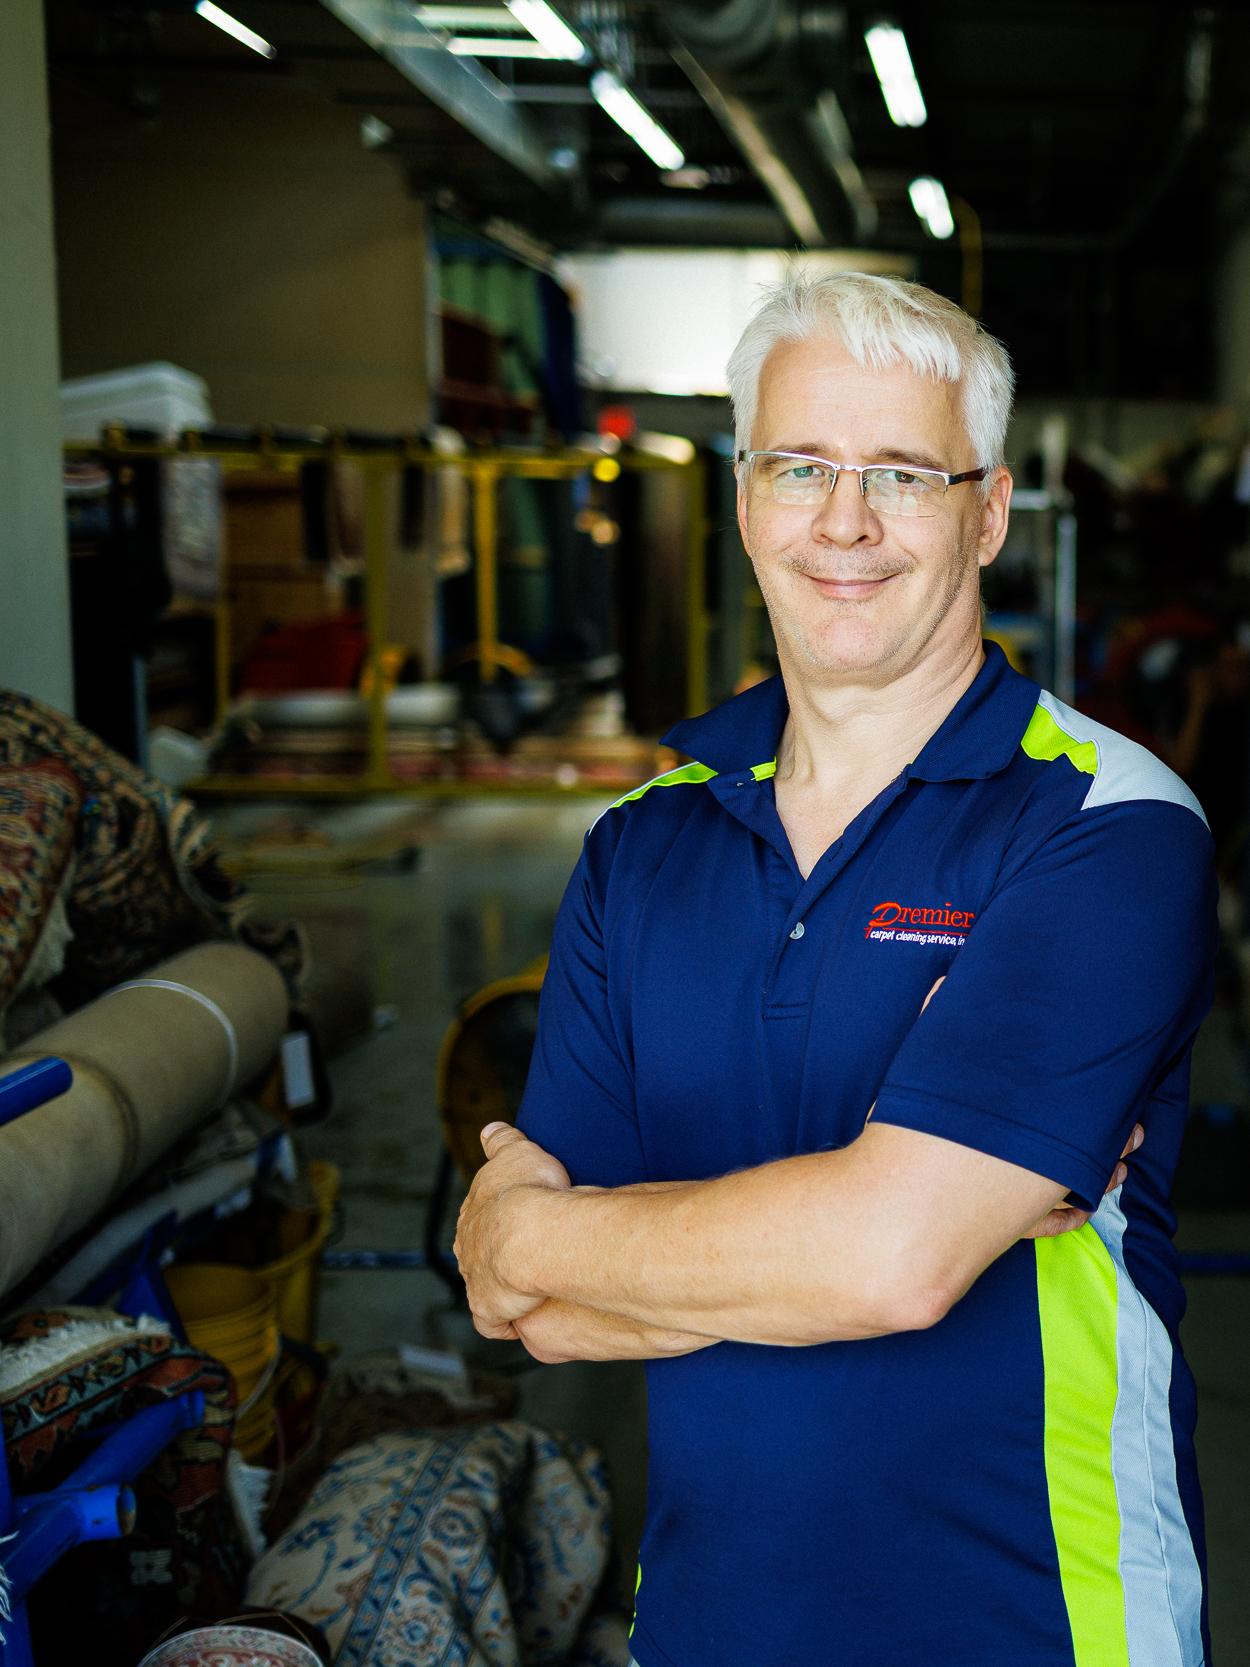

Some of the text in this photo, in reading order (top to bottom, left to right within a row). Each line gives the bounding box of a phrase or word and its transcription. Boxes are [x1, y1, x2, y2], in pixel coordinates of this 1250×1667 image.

[864, 901, 975, 939] Premier
[870, 930, 895, 942] carpet
[895, 931, 926, 945] cleaning
[927, 934, 956, 946] service,
